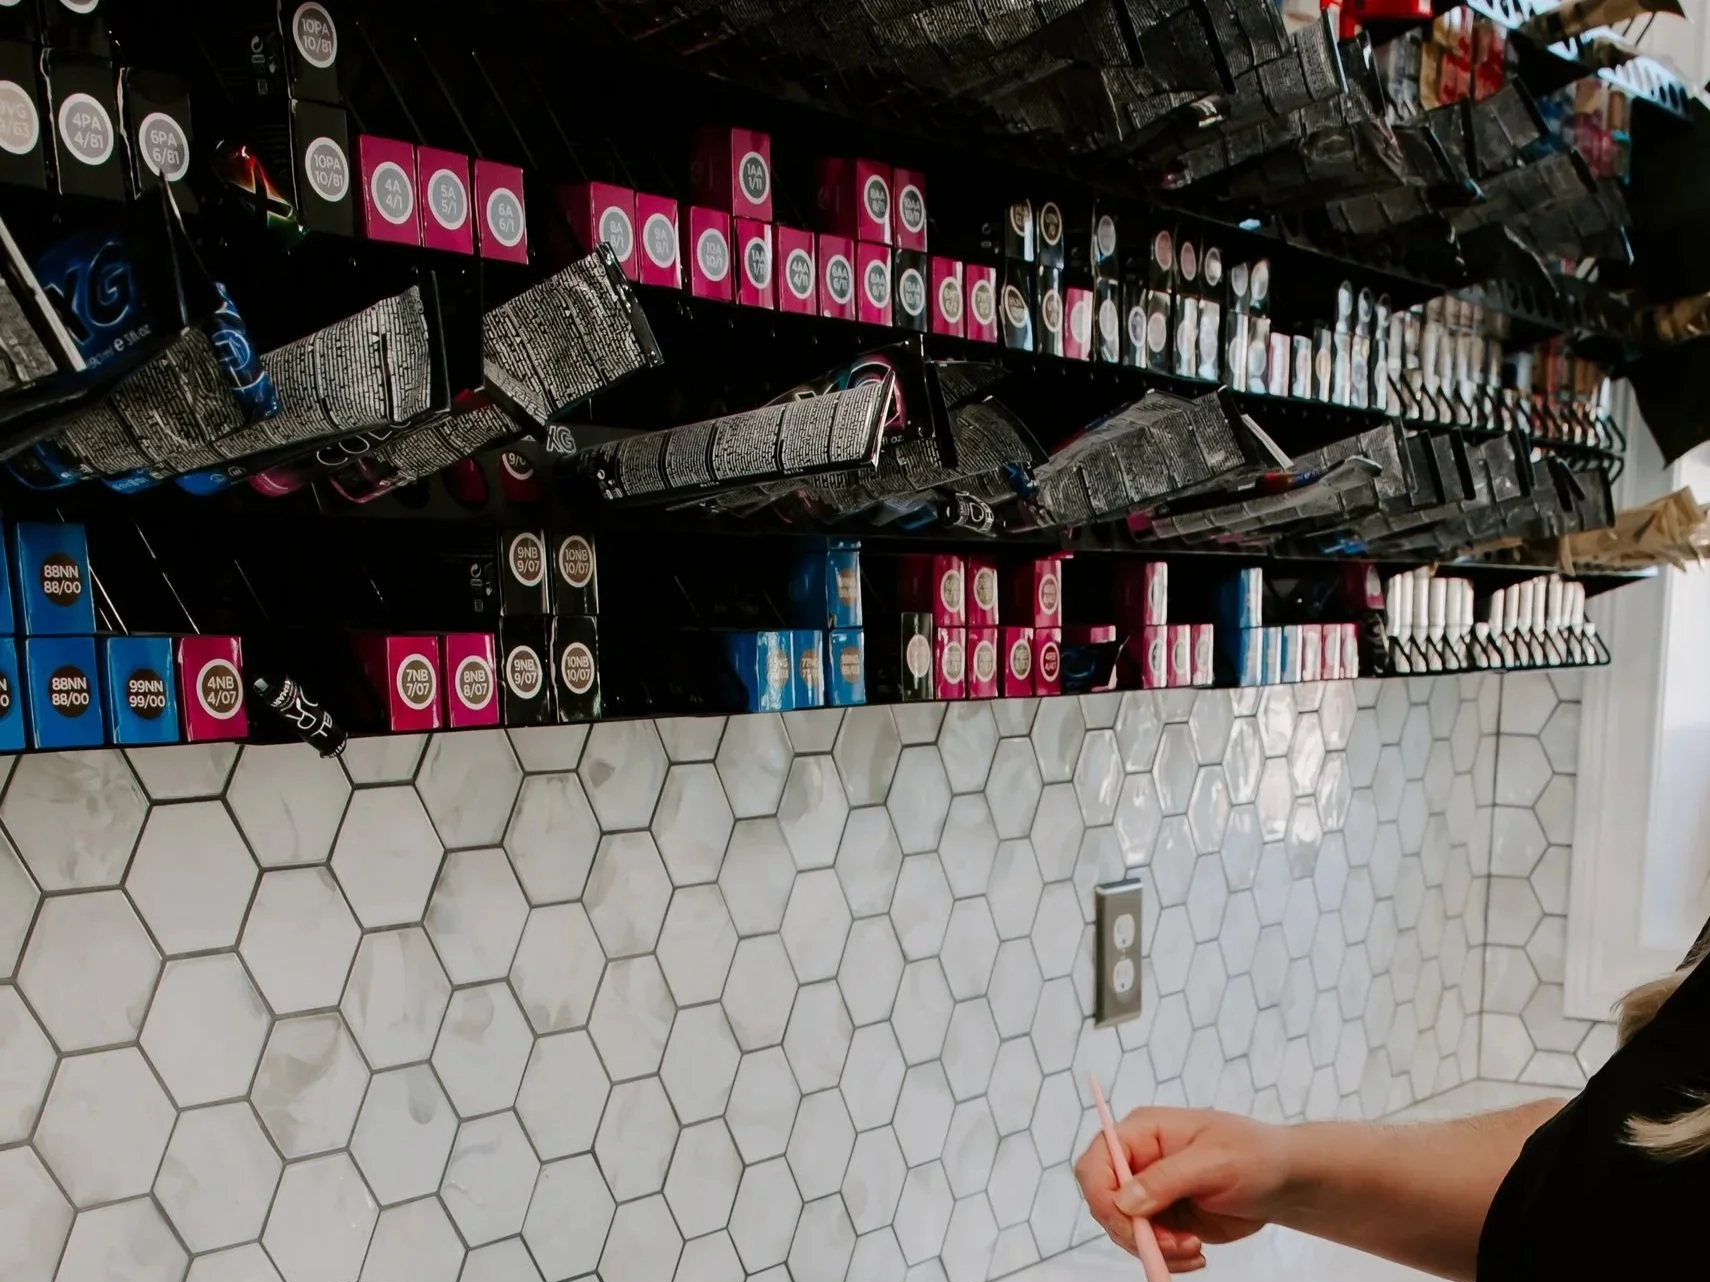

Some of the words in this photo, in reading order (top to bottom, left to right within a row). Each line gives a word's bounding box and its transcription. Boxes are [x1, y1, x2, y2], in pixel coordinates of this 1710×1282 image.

[301, 17, 331, 37] 10PA
[302, 35, 333, 53] 10/81
[72, 112, 103, 132] 4PA
[73, 130, 105, 150] 4/81
[150, 129, 179, 148] 6PA
[151, 147, 182, 166] 6/81
[313, 153, 343, 171] 10PA
[314, 169, 344, 188] 10/81
[384, 178, 402, 194] 4A
[440, 184, 457, 200] 5A
[385, 193, 403, 210] 4/1
[441, 201, 458, 215] 5/1
[498, 202, 514, 217] 6A
[498, 216, 516, 233] 6/1
[791, 259, 809, 274] 4AA
[793, 272, 809, 287] 4/11
[517, 546, 539, 560] 9NB
[565, 548, 589, 562] 10NB
[43, 564, 80, 579] 88NN
[516, 560, 541, 575] 9/07
[565, 560, 590, 576] 10/07
[43, 578, 82, 597] 88/00
[514, 658, 536, 672] 9NB
[566, 655, 590, 669] 10NB
[207, 675, 235, 691] 4NB
[406, 668, 430, 683] 7NB
[463, 669, 486, 684] 8NB
[514, 671, 538, 686] 9/07
[566, 667, 591, 683] 10/07
[51, 676, 87, 691] 88NN
[128, 679, 164, 694] 99NN
[406, 682, 430, 698] 7/07
[463, 682, 488, 699] 8/07
[51, 690, 90, 709] 88/00
[128, 693, 166, 710] 99/00
[207, 690, 237, 707] 4/07
